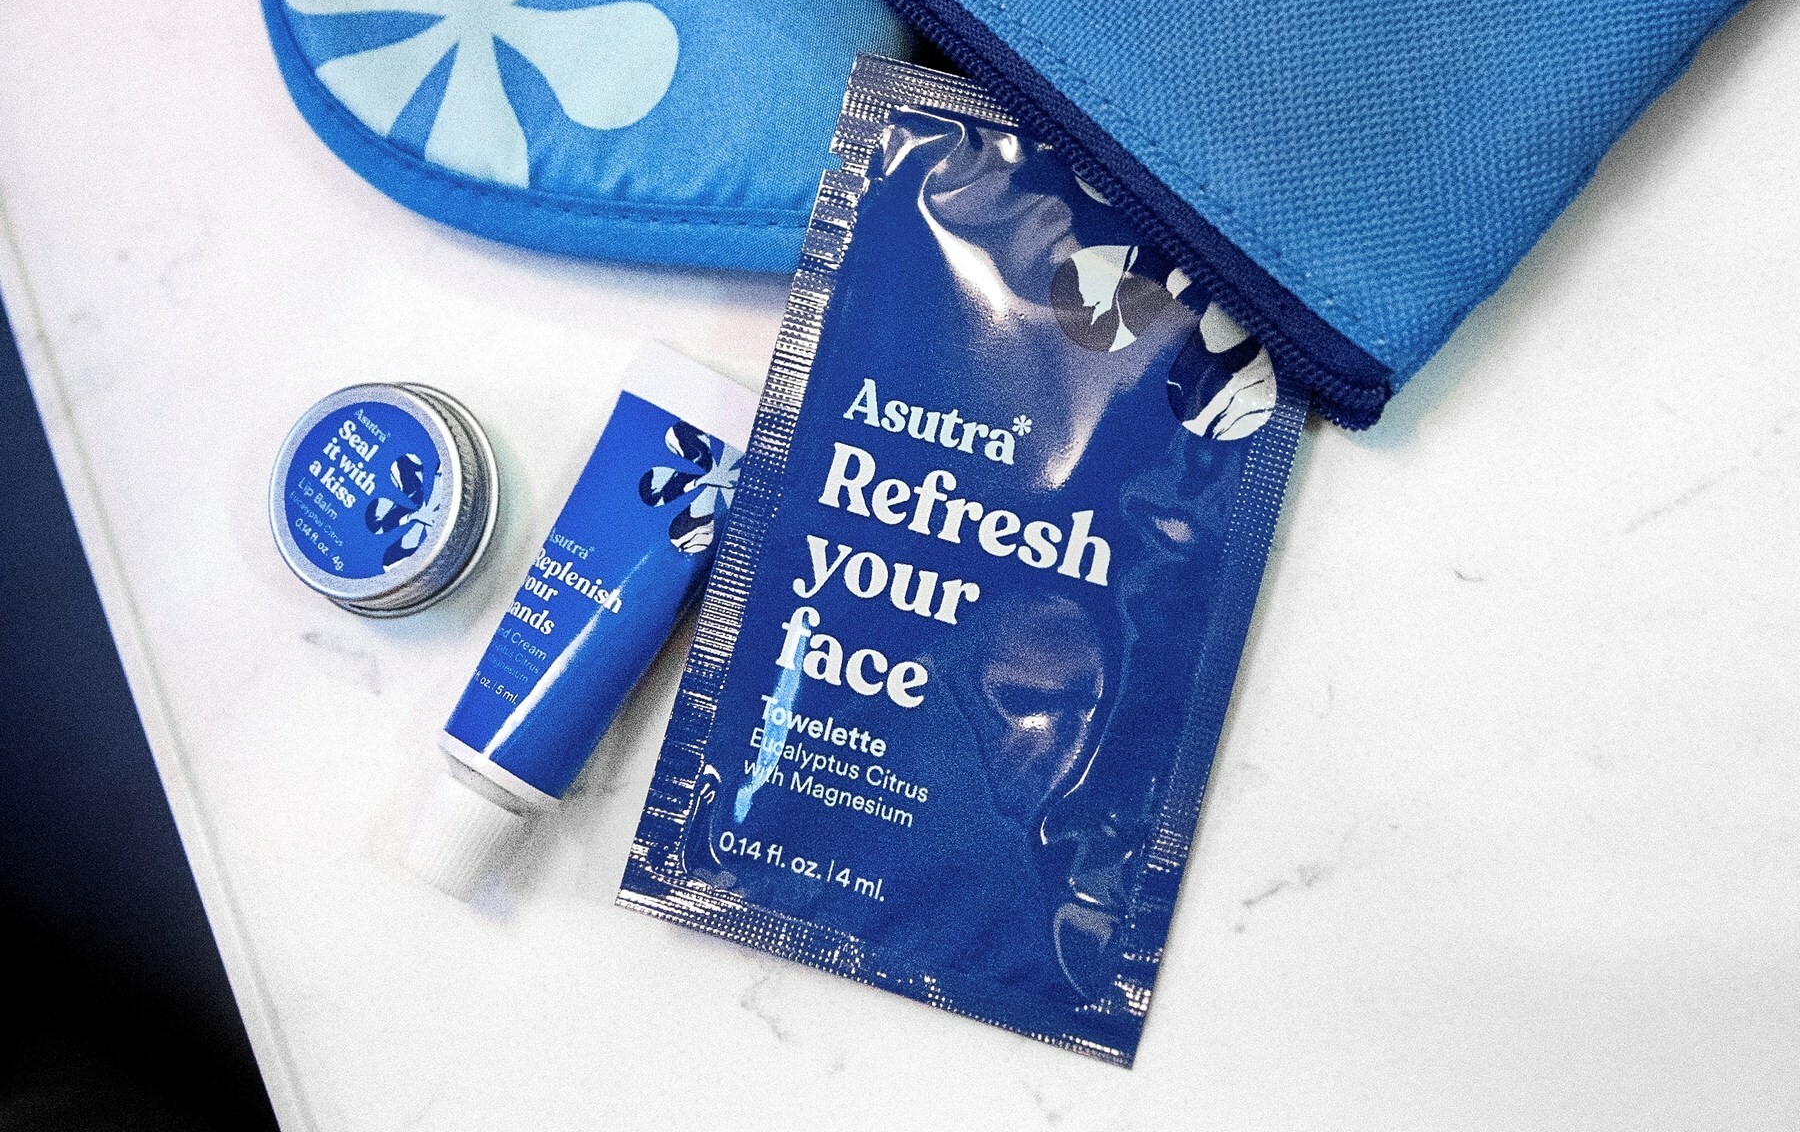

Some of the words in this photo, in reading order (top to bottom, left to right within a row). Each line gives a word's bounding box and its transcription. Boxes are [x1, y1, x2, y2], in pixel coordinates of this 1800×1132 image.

[323, 437, 341, 461] it
[340, 455, 376, 496] with
[339, 420, 379, 462] Seal
[298, 476, 314, 497] Lip
[314, 492, 338, 520] Balm
[309, 460, 322, 477] a
[320, 467, 356, 508] kiss
[818, 442, 1111, 586] Refresh
[317, 542, 329, 557] oz.
[332, 555, 344, 572] 4g.
[792, 535, 980, 625] your
[524, 575, 558, 602] our
[507, 601, 556, 635] ands
[511, 632, 547, 661] Cream
[775, 606, 929, 708] face
[480, 677, 491, 689] oz.
[495, 684, 505, 695] 5
[502, 691, 519, 705] ml.
[761, 695, 887, 757] Towelette
[750, 728, 860, 780] Eucalyptus
[866, 765, 928, 803] Citrus
[744, 759, 784, 787] with
[790, 771, 913, 827] Magnesium
[719, 831, 761, 860] 0.14
[767, 844, 786, 868] fl.
[791, 857, 822, 880] oz.
[836, 868, 850, 888] 4
[854, 876, 885, 902] ml.
